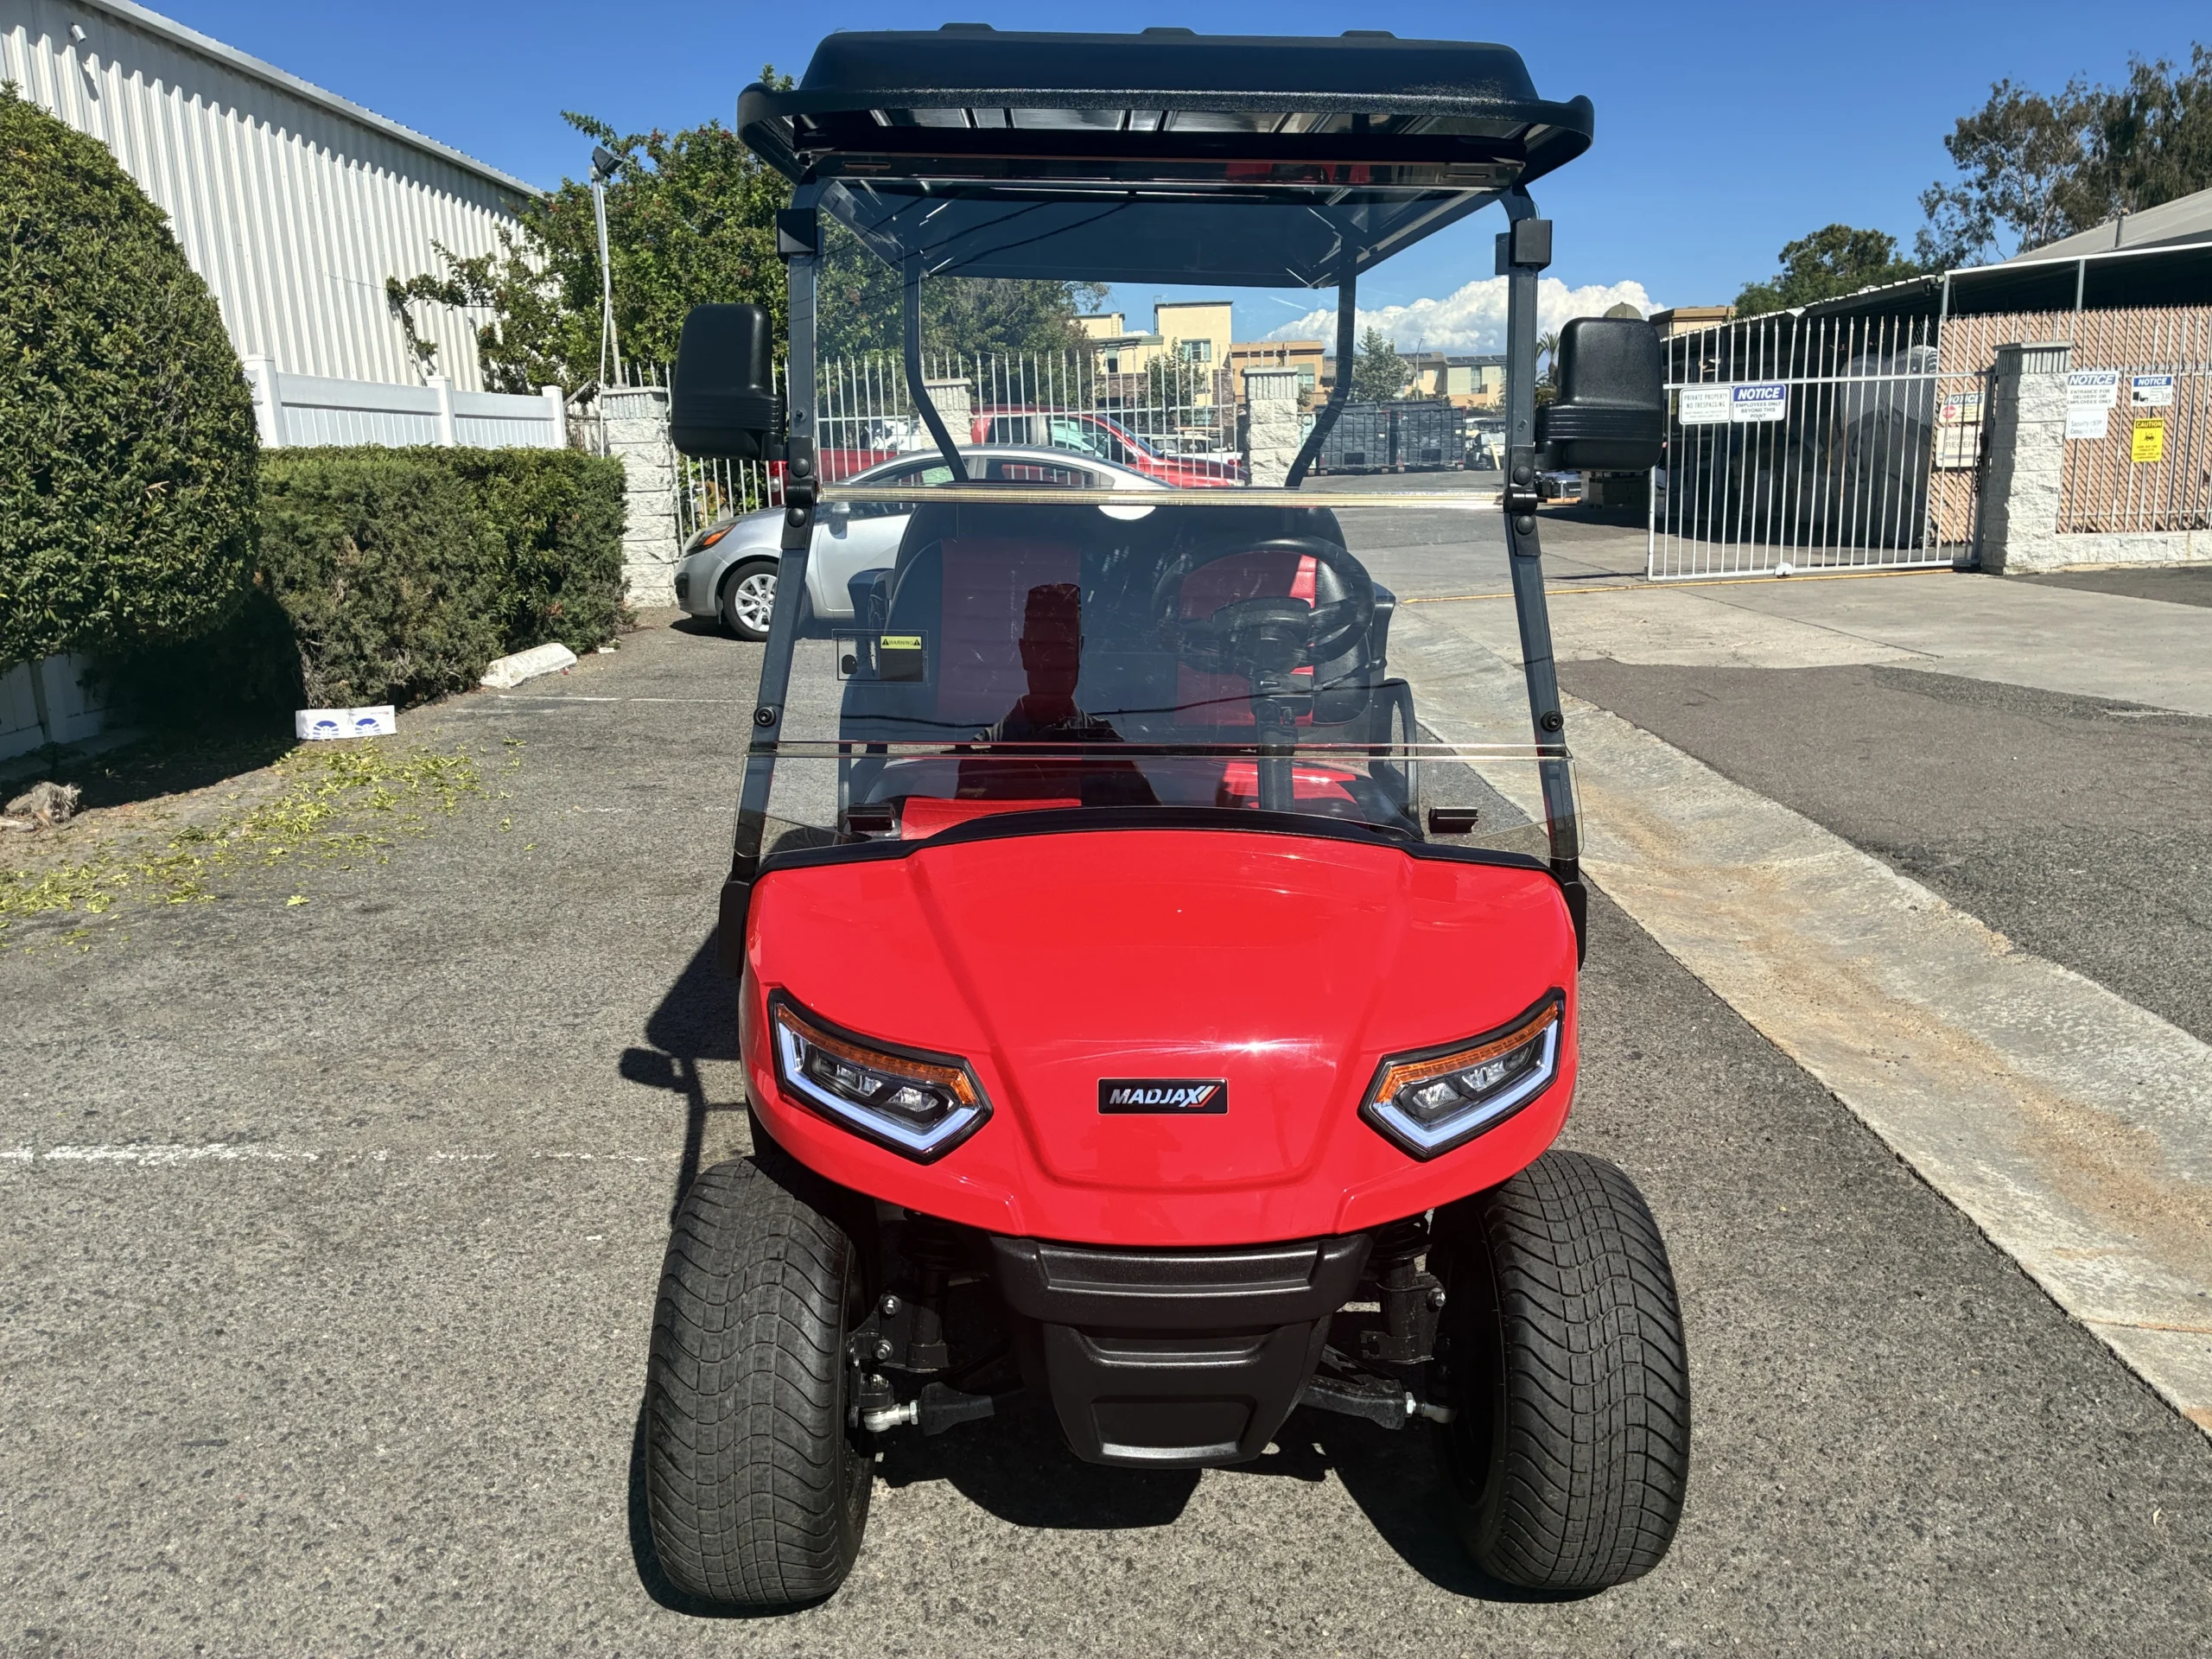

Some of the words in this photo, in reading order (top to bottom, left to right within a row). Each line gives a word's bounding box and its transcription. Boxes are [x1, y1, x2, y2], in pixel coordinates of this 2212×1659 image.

[2069, 374, 2115, 385] NOTICE
[2138, 378, 2167, 386] NOTICE
[1738, 387, 1781, 400] NOTICE
[1109, 1085, 1210, 1108] MADJAX
